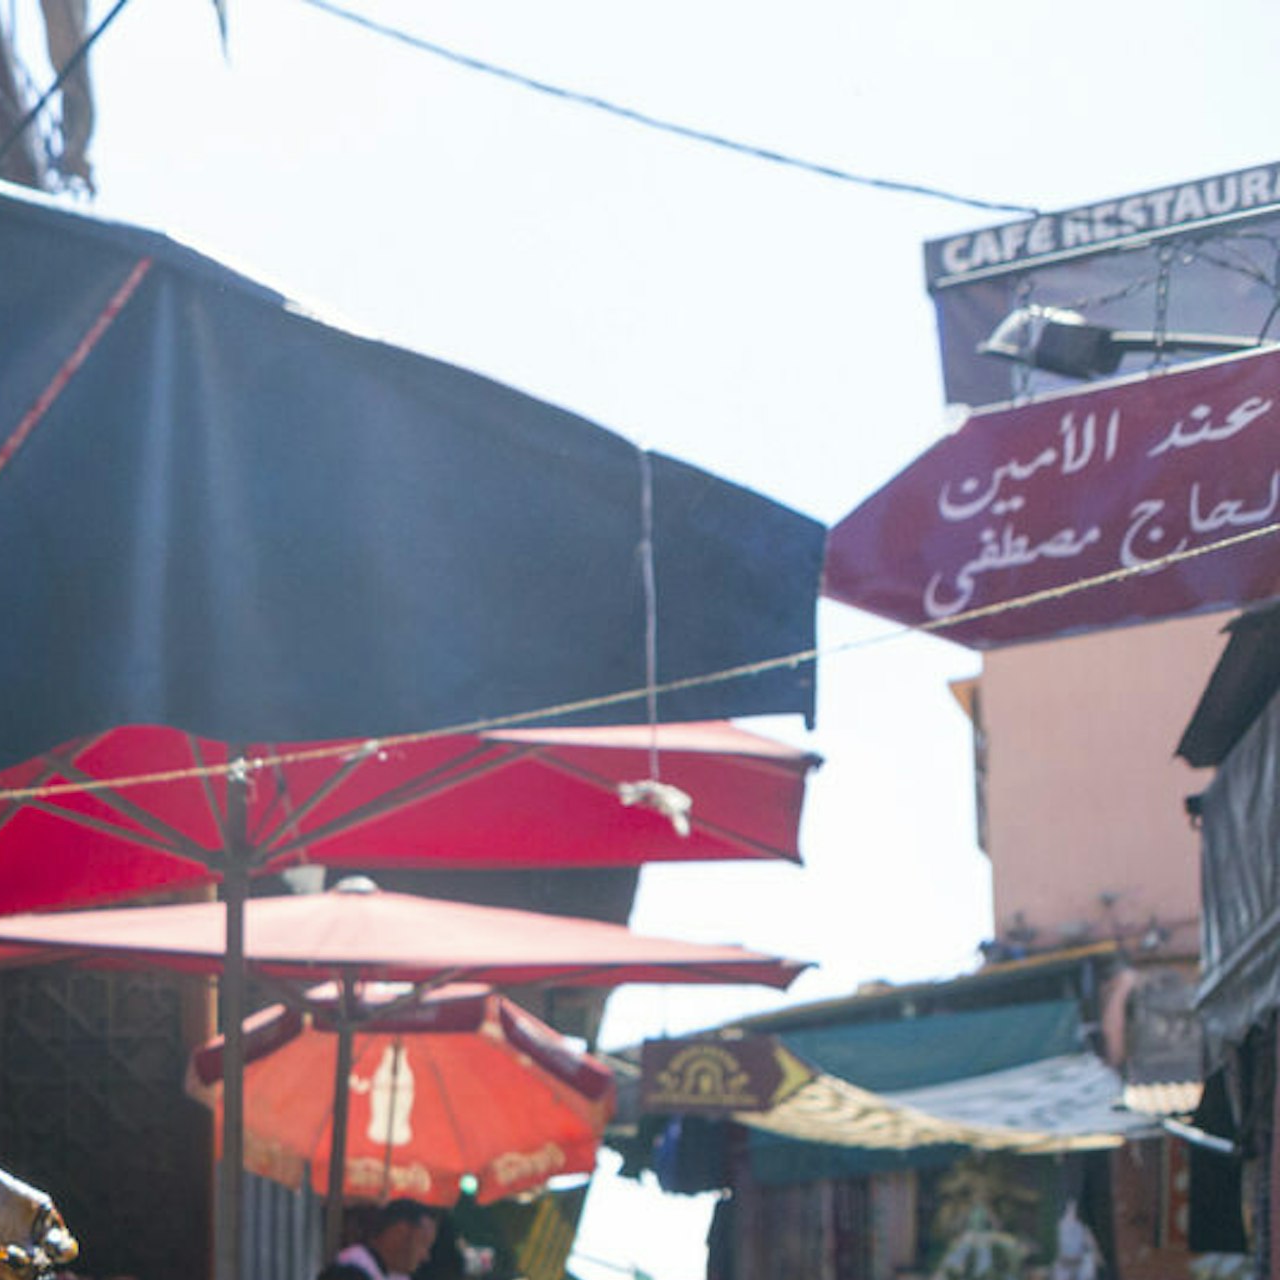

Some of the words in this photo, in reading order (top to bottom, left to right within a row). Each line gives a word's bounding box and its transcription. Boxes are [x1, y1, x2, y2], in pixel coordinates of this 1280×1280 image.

[1061, 169, 1280, 248] RESTAUR
[938, 407, 1121, 521] الأمين
[1147, 395, 1274, 458] عند
[1120, 466, 1280, 575] لحاج
[923, 522, 1101, 619] مصطفى
